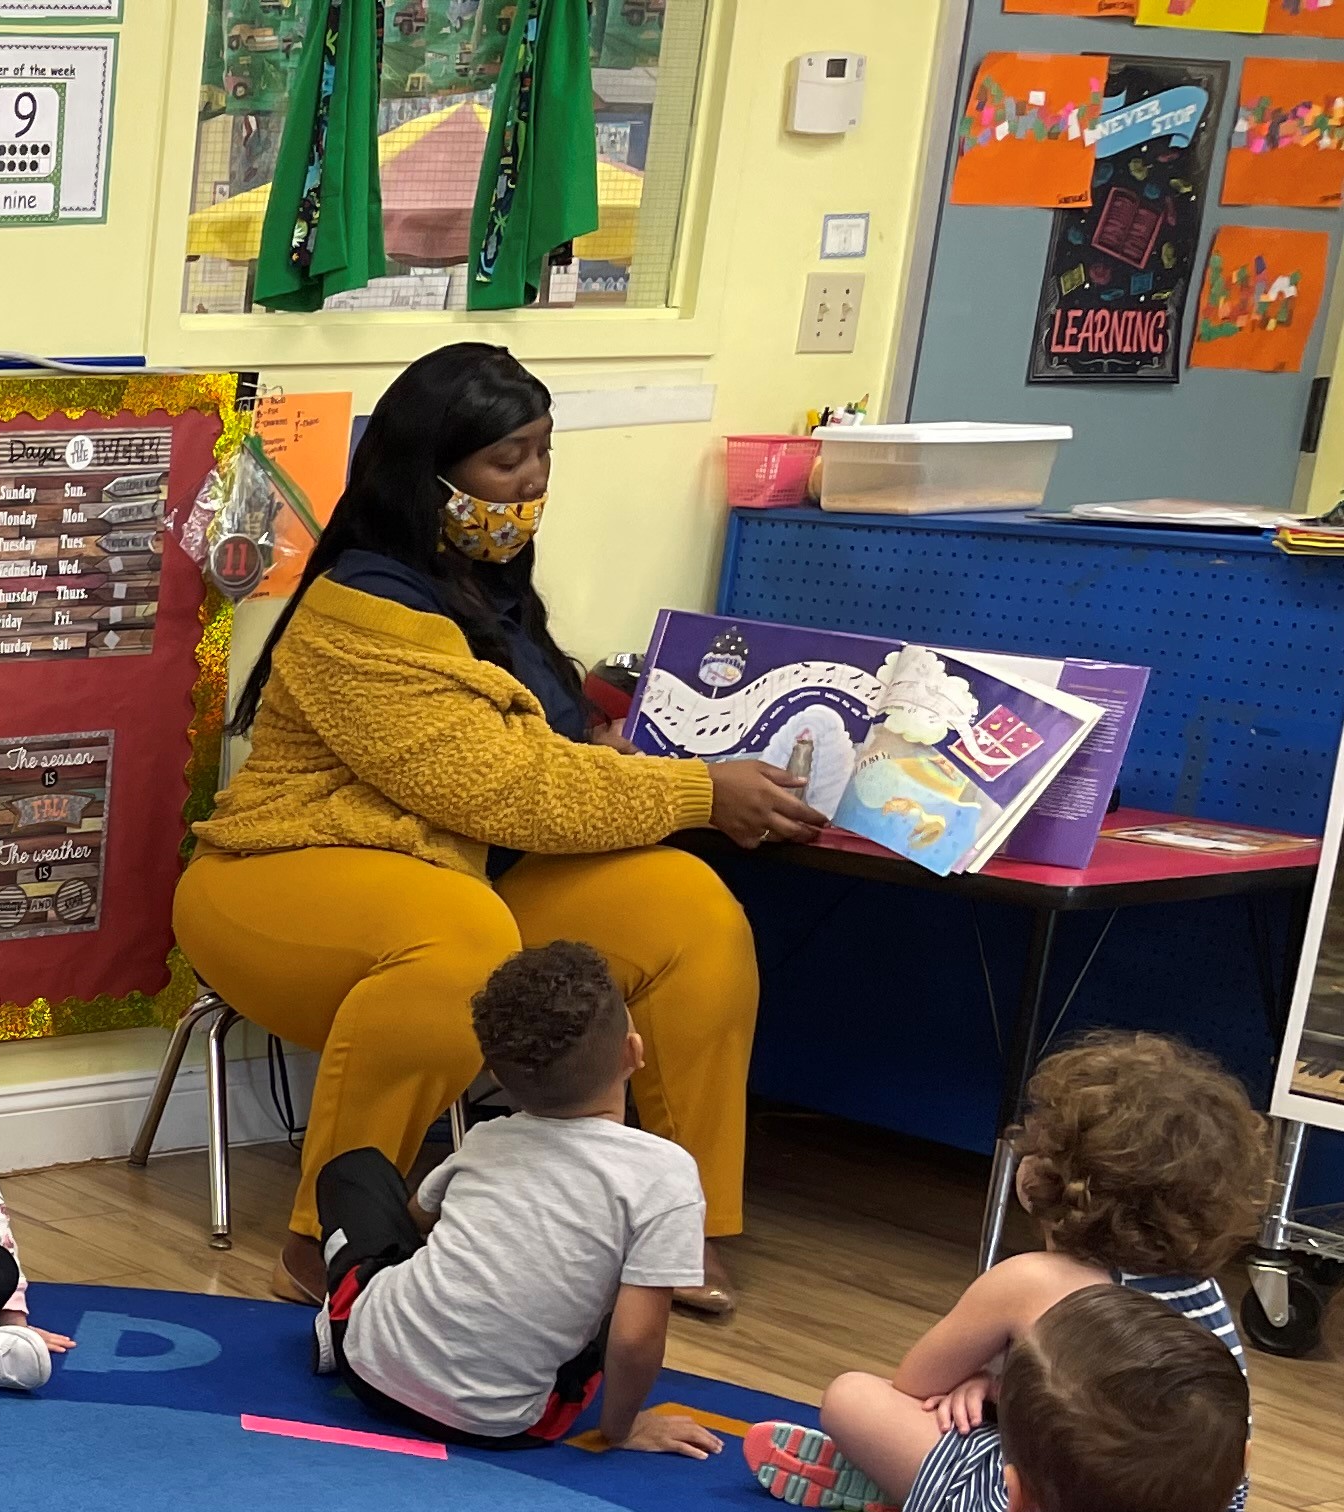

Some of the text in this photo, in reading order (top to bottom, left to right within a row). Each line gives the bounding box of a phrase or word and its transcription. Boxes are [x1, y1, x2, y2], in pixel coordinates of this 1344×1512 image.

[13, 65, 26, 76] of
[30, 65, 47, 76] the
[50, 65, 76, 77] week
[14, 92, 37, 138] 9
[1096, 100, 1162, 138] NEVER
[1150, 104, 1198, 136] STOP
[3, 190, 37, 209] nine
[1050, 308, 1166, 355] LEARNING
[8, 440, 62, 467] Days
[70, 450, 90, 463] THE
[73, 439, 86, 450] OF
[0, 486, 37, 503] Sunday
[222, 543, 247, 576] 11
[7, 747, 94, 771] The season
[45, 772, 56, 786] IS
[0, 840, 91, 866] The weather
[38, 867, 50, 880] IS
[64, 1310, 221, 1373] D
